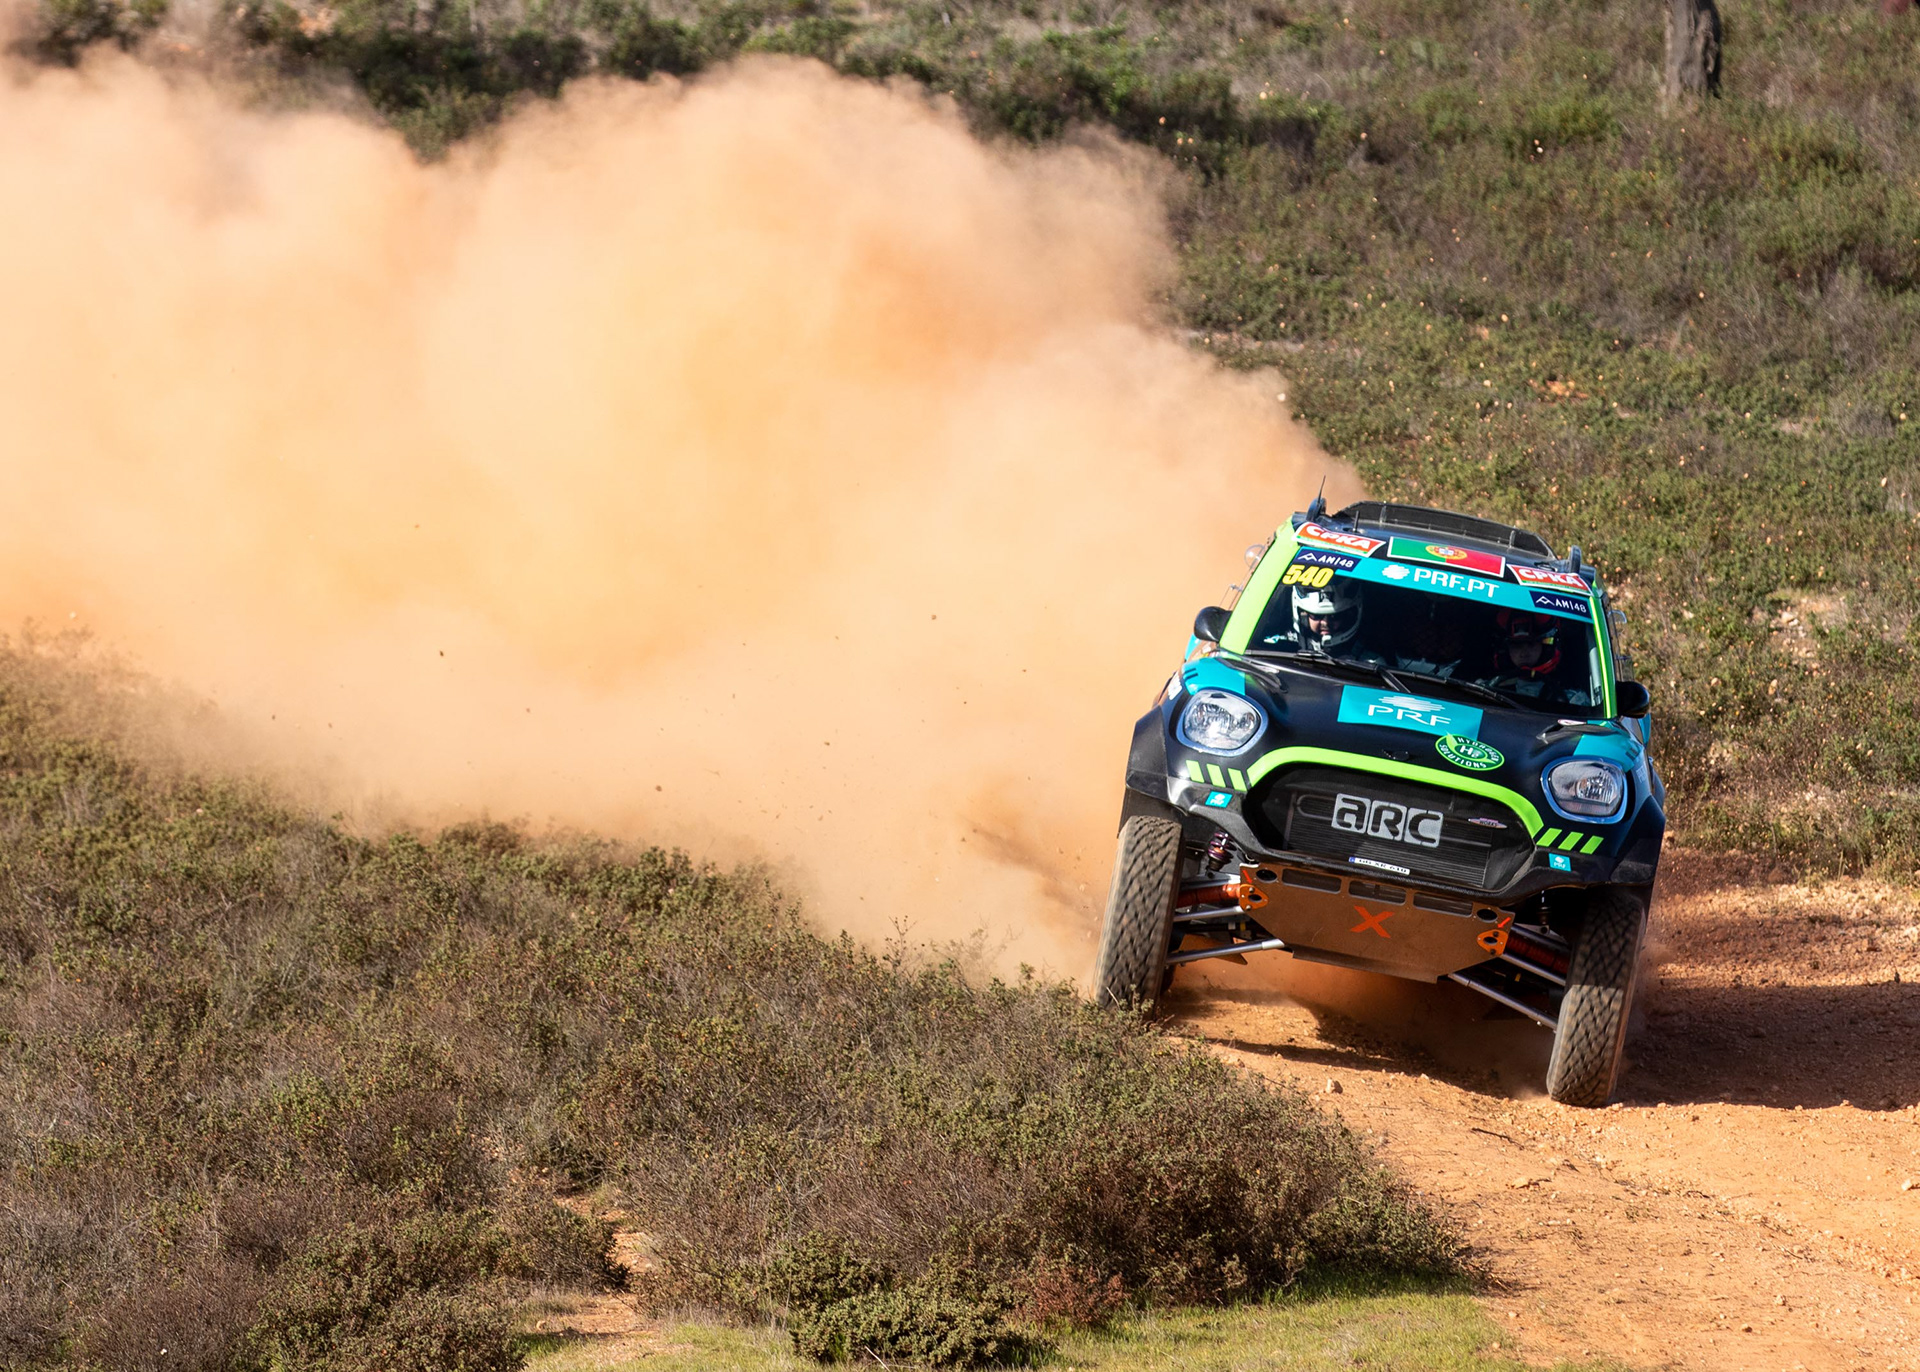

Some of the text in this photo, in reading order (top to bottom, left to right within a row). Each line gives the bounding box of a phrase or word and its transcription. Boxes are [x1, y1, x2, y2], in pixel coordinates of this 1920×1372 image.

[1306, 525, 1371, 549] CPKA
[1282, 564, 1334, 588] 540
[1413, 568, 1500, 598] PRF.PT
[1519, 568, 1583, 587] CPKA
[1367, 704, 1452, 727] PRF
